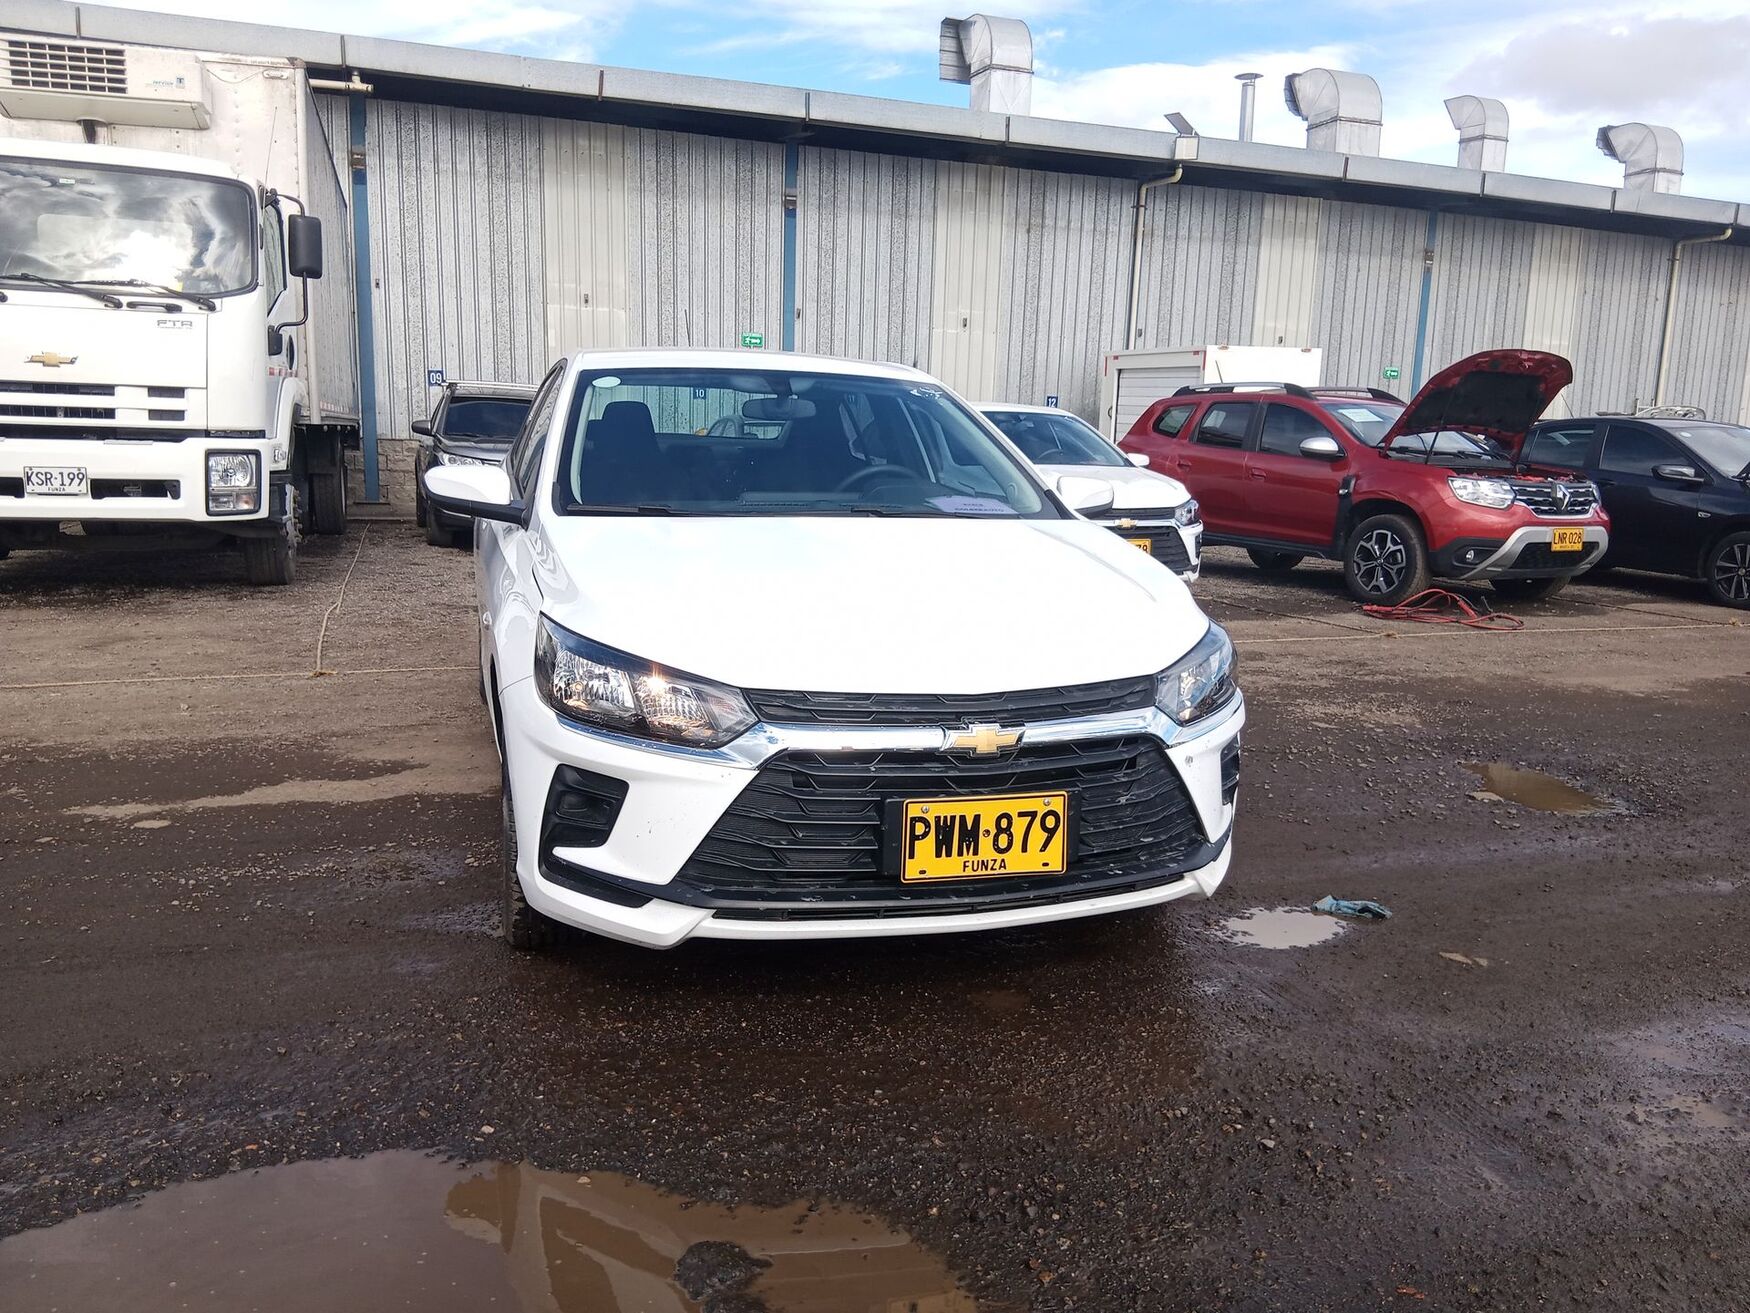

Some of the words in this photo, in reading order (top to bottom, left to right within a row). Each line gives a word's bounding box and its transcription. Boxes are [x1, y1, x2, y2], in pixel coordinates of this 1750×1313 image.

[430, 372, 442, 384] 09
[695, 389, 705, 398] 10
[1048, 397, 1057, 408] 12
[1553, 532, 1568, 545] LNR
[1569, 532, 1582, 545] 028
[962, 858, 1007, 873] FUNZA
